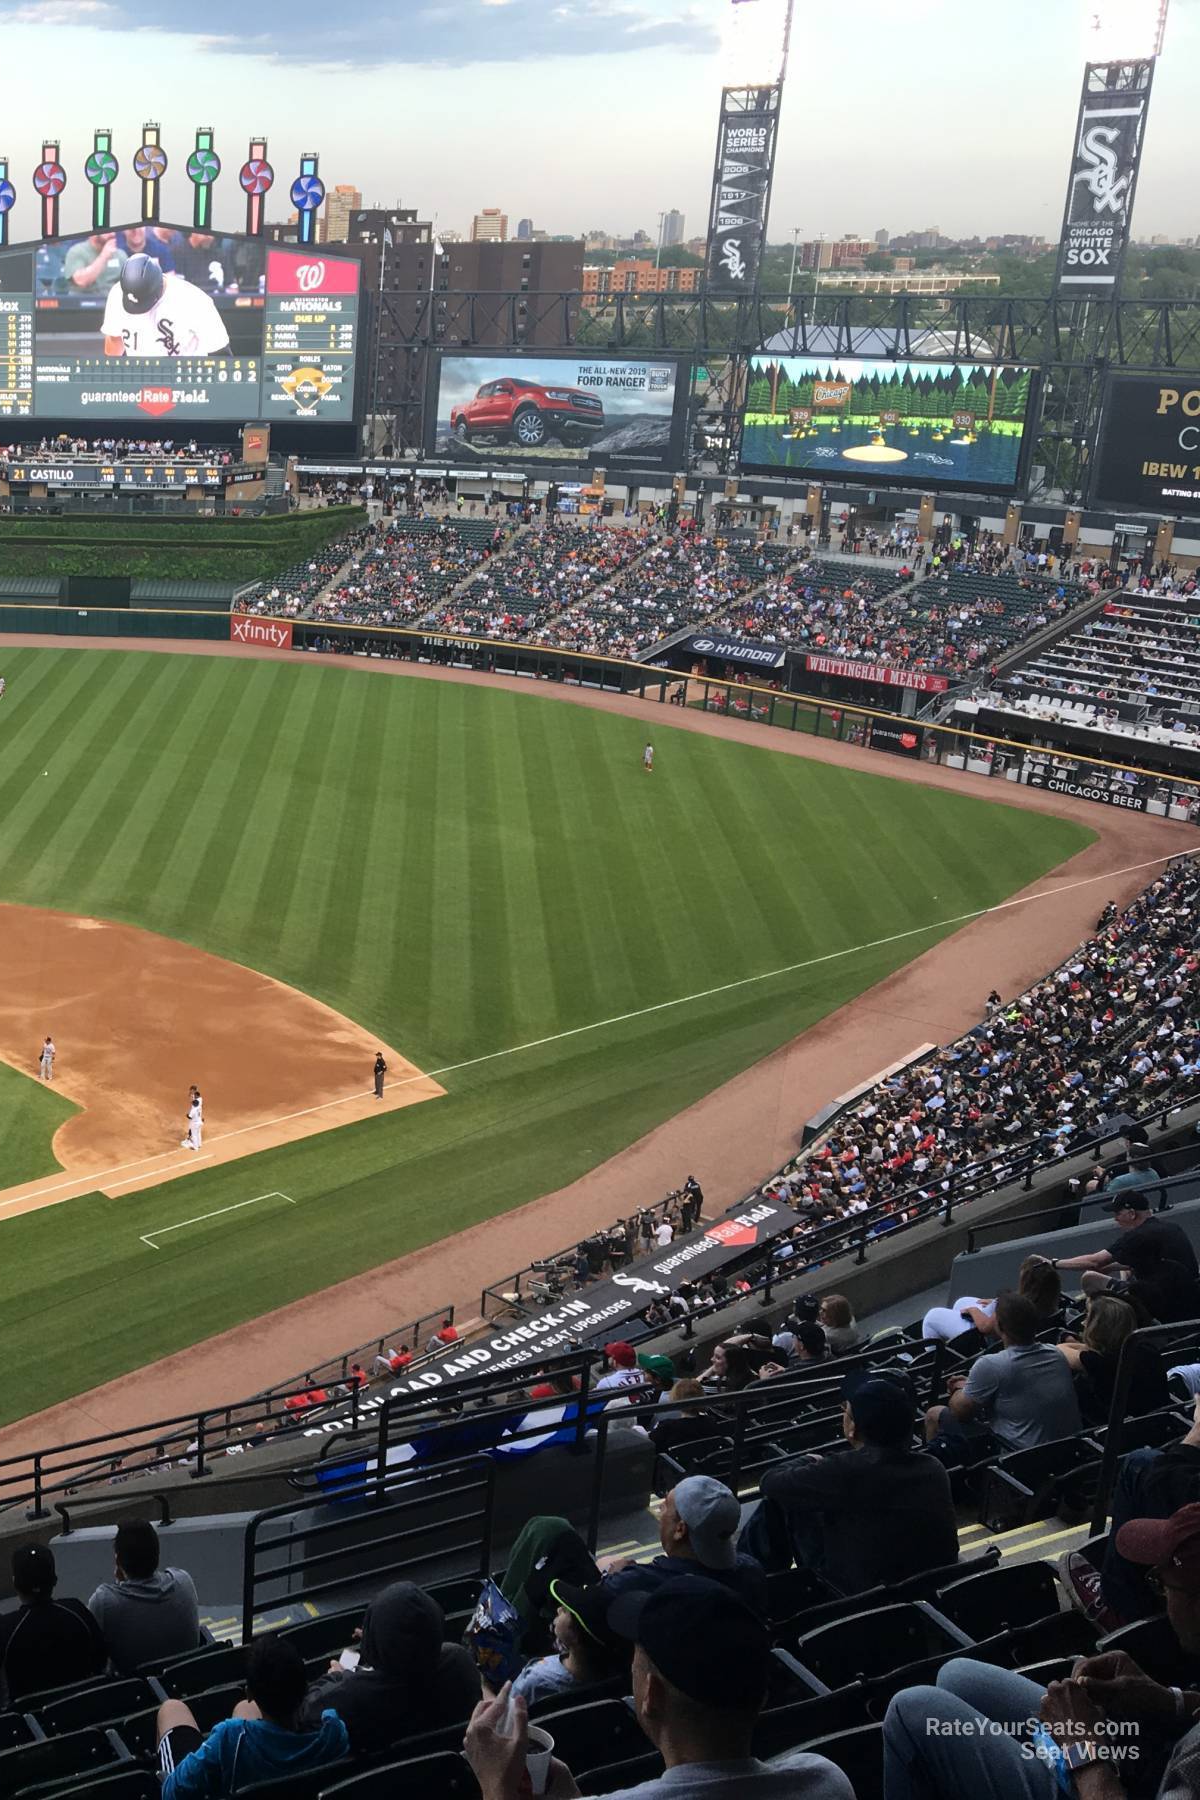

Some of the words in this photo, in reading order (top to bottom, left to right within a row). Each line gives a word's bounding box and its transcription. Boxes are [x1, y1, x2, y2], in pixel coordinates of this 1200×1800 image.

[727, 128, 767, 138] WORLD
[726, 137, 766, 147] SERIES
[1070, 228, 1114, 236] CHICAGO
[1069, 238, 1112, 247] WHITE
[1067, 249, 1110, 265] SOX
[280, 301, 342, 311] NATIONALS
[220, 361, 226, 369] B
[234, 361, 241, 369] S
[248, 361, 255, 369] O
[219, 370, 227, 381] 0
[233, 370, 242, 381] 0
[248, 370, 257, 381] 2
[594, 367, 626, 375] ALL-NEW
[628, 367, 647, 375] 2019
[651, 369, 668, 377] BUILT
[577, 376, 603, 386] FORD
[605, 376, 646, 387] RANGER
[81, 391, 142, 405] guaranteed
[143, 390, 169, 403] Rate
[815, 385, 849, 401] Chicago
[793, 411, 809, 420] 329
[955, 415, 971, 425] 330
[704, 435, 731, 449] 7:41
[14, 470, 24, 479] 21
[30, 470, 73, 480] CASTILLO
[1142, 461, 1188, 479] IBEW
[1162, 488, 1192, 498] BATTING
[233, 620, 289, 647] xfinity
[422, 637, 445, 646] THE
[448, 638, 480, 650] PATIO
[715, 644, 777, 663] HYUNDAI
[810, 655, 886, 683] WHITTINGHAM
[889, 670, 927, 690] MEATS
[1049, 779, 1109, 801] CHICAGO'S
[1112, 794, 1143, 809] BEER
[653, 1237, 720, 1275] guaranteed
[713, 1222, 743, 1241] Rate
[734, 1204, 778, 1227] Field
[530, 1344, 544, 1354] &
[546, 1328, 573, 1348] SEAT
[569, 1298, 632, 1332] UPGRADES
[442, 1349, 492, 1377] AND
[490, 1299, 592, 1352] CHECK-IN
